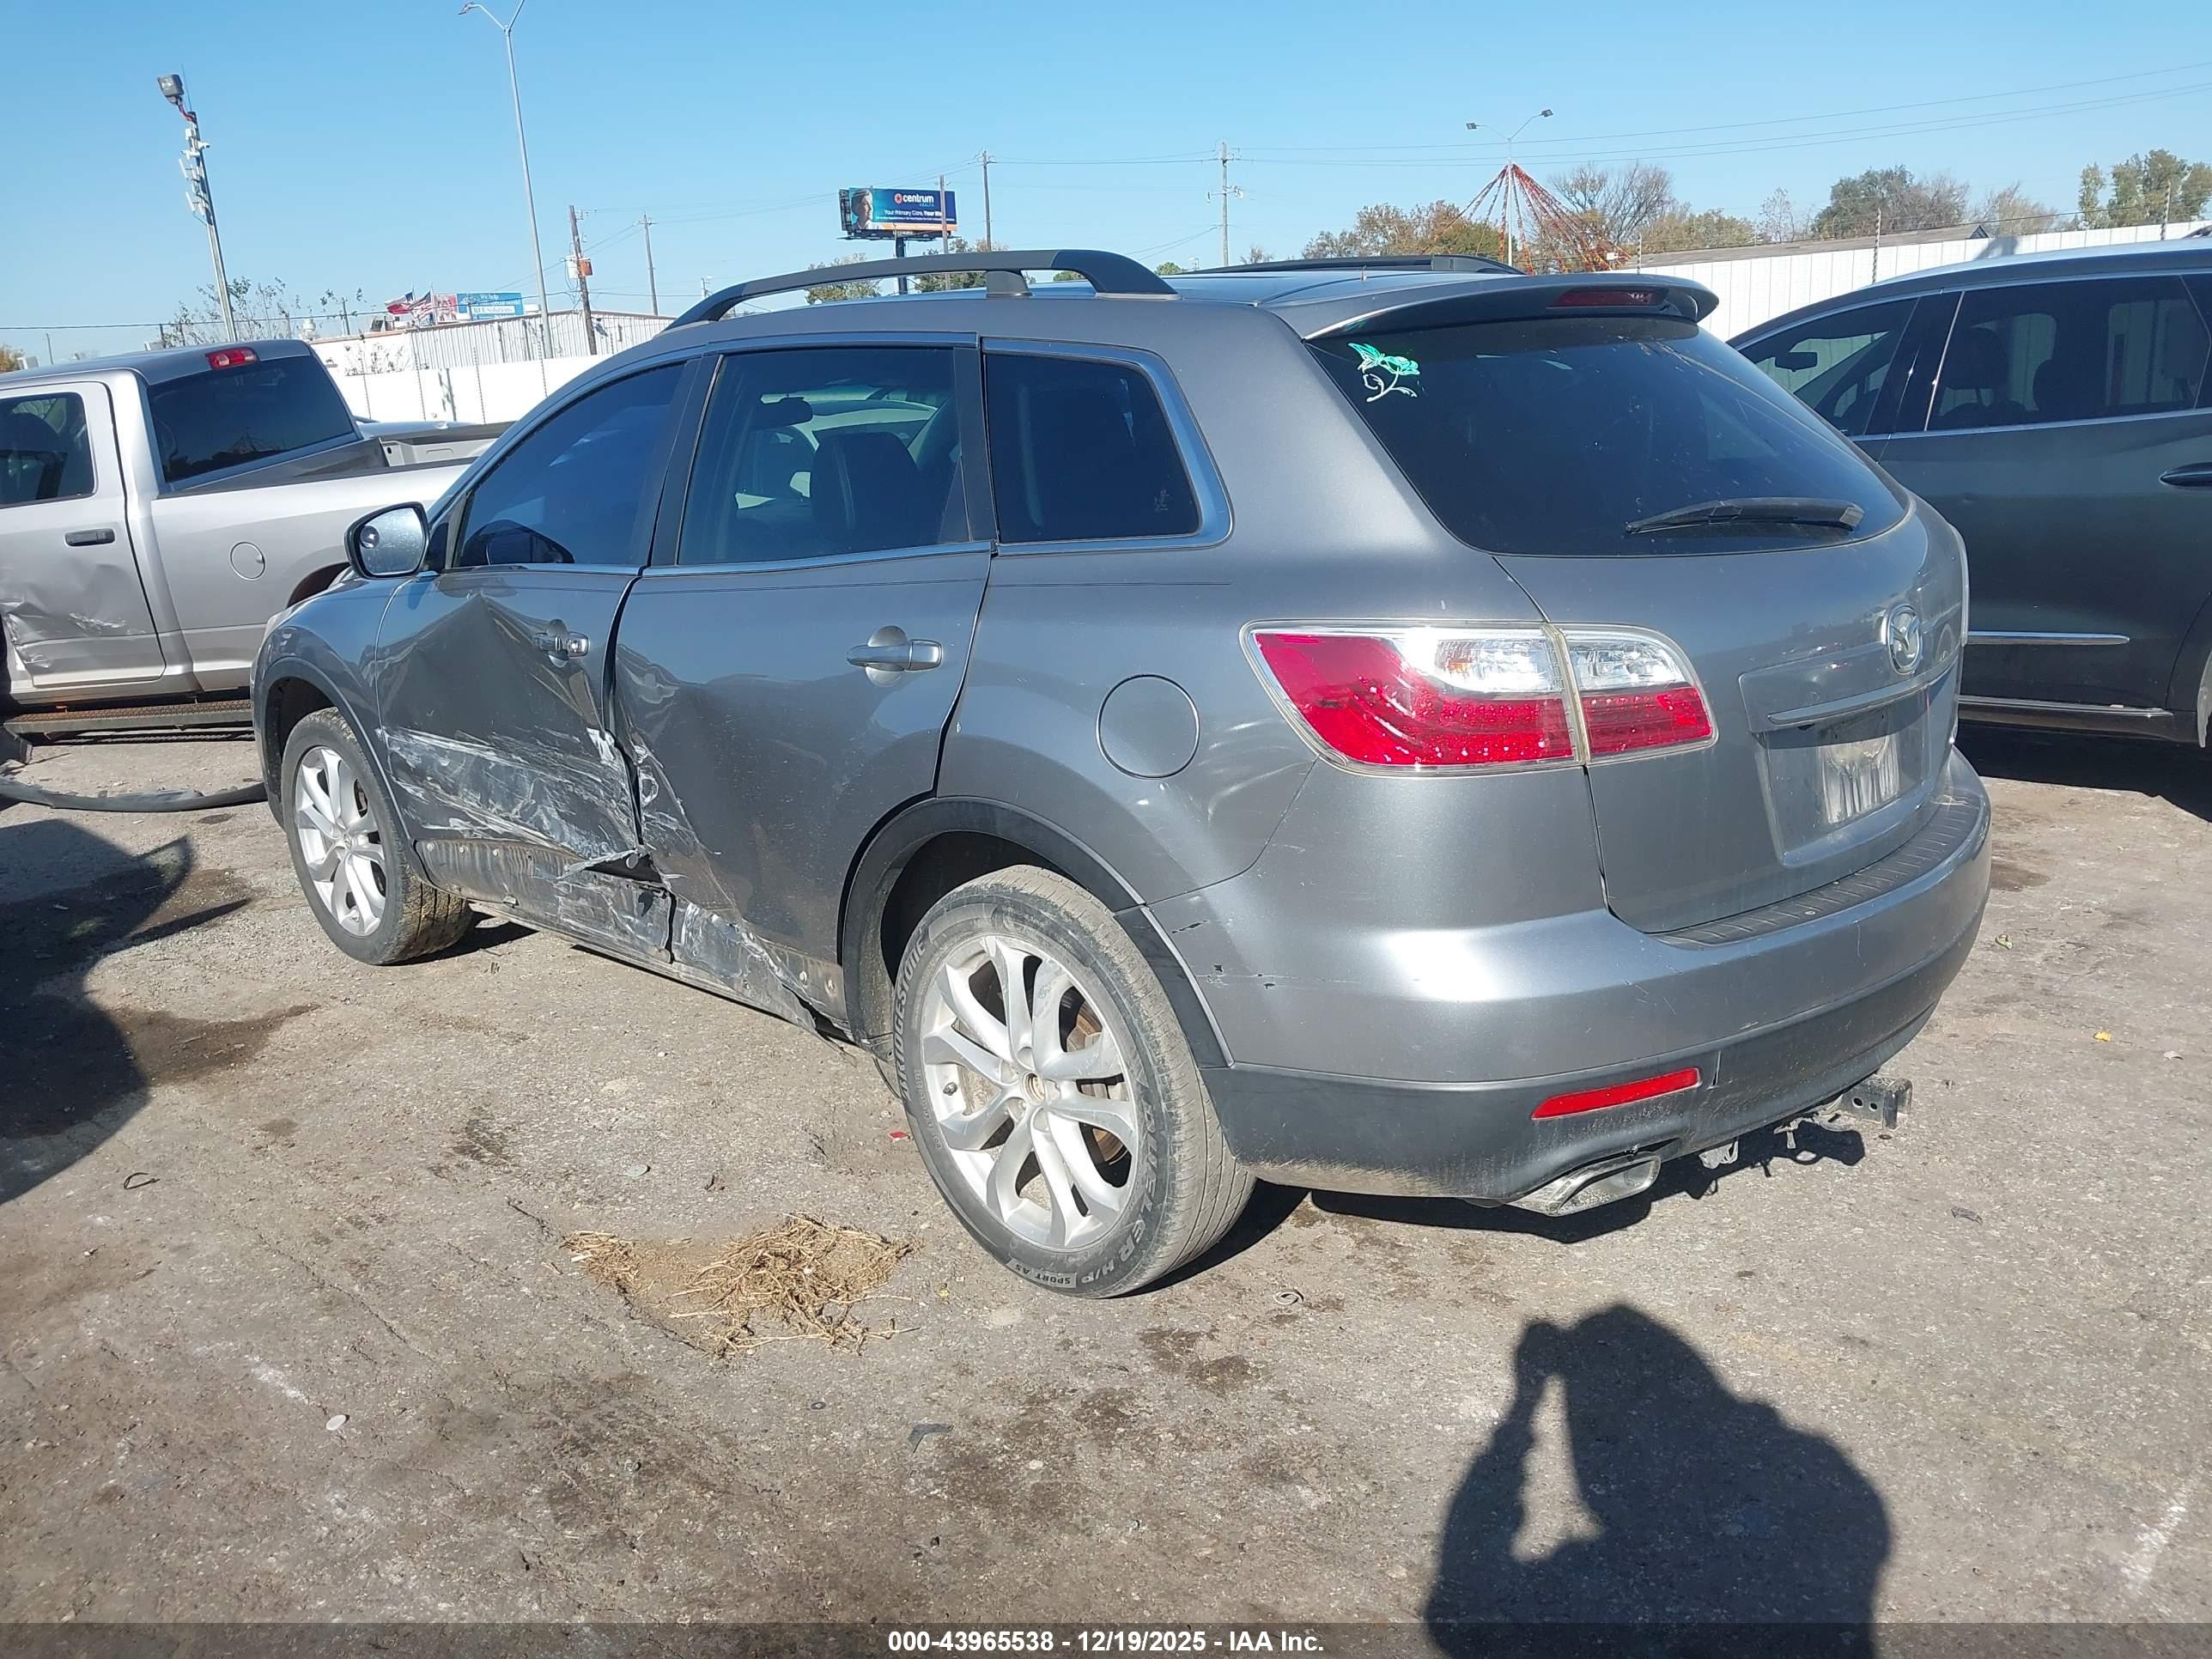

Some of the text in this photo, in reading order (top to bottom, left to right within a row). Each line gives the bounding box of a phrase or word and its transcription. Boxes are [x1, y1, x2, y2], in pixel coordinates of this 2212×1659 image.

[902, 194, 934, 203] centrum
[894, 936, 927, 1101] BRIDGESTONE
[1119, 1098, 1158, 1262] DUELER
[1015, 1263, 1072, 1285] SPORT AS
